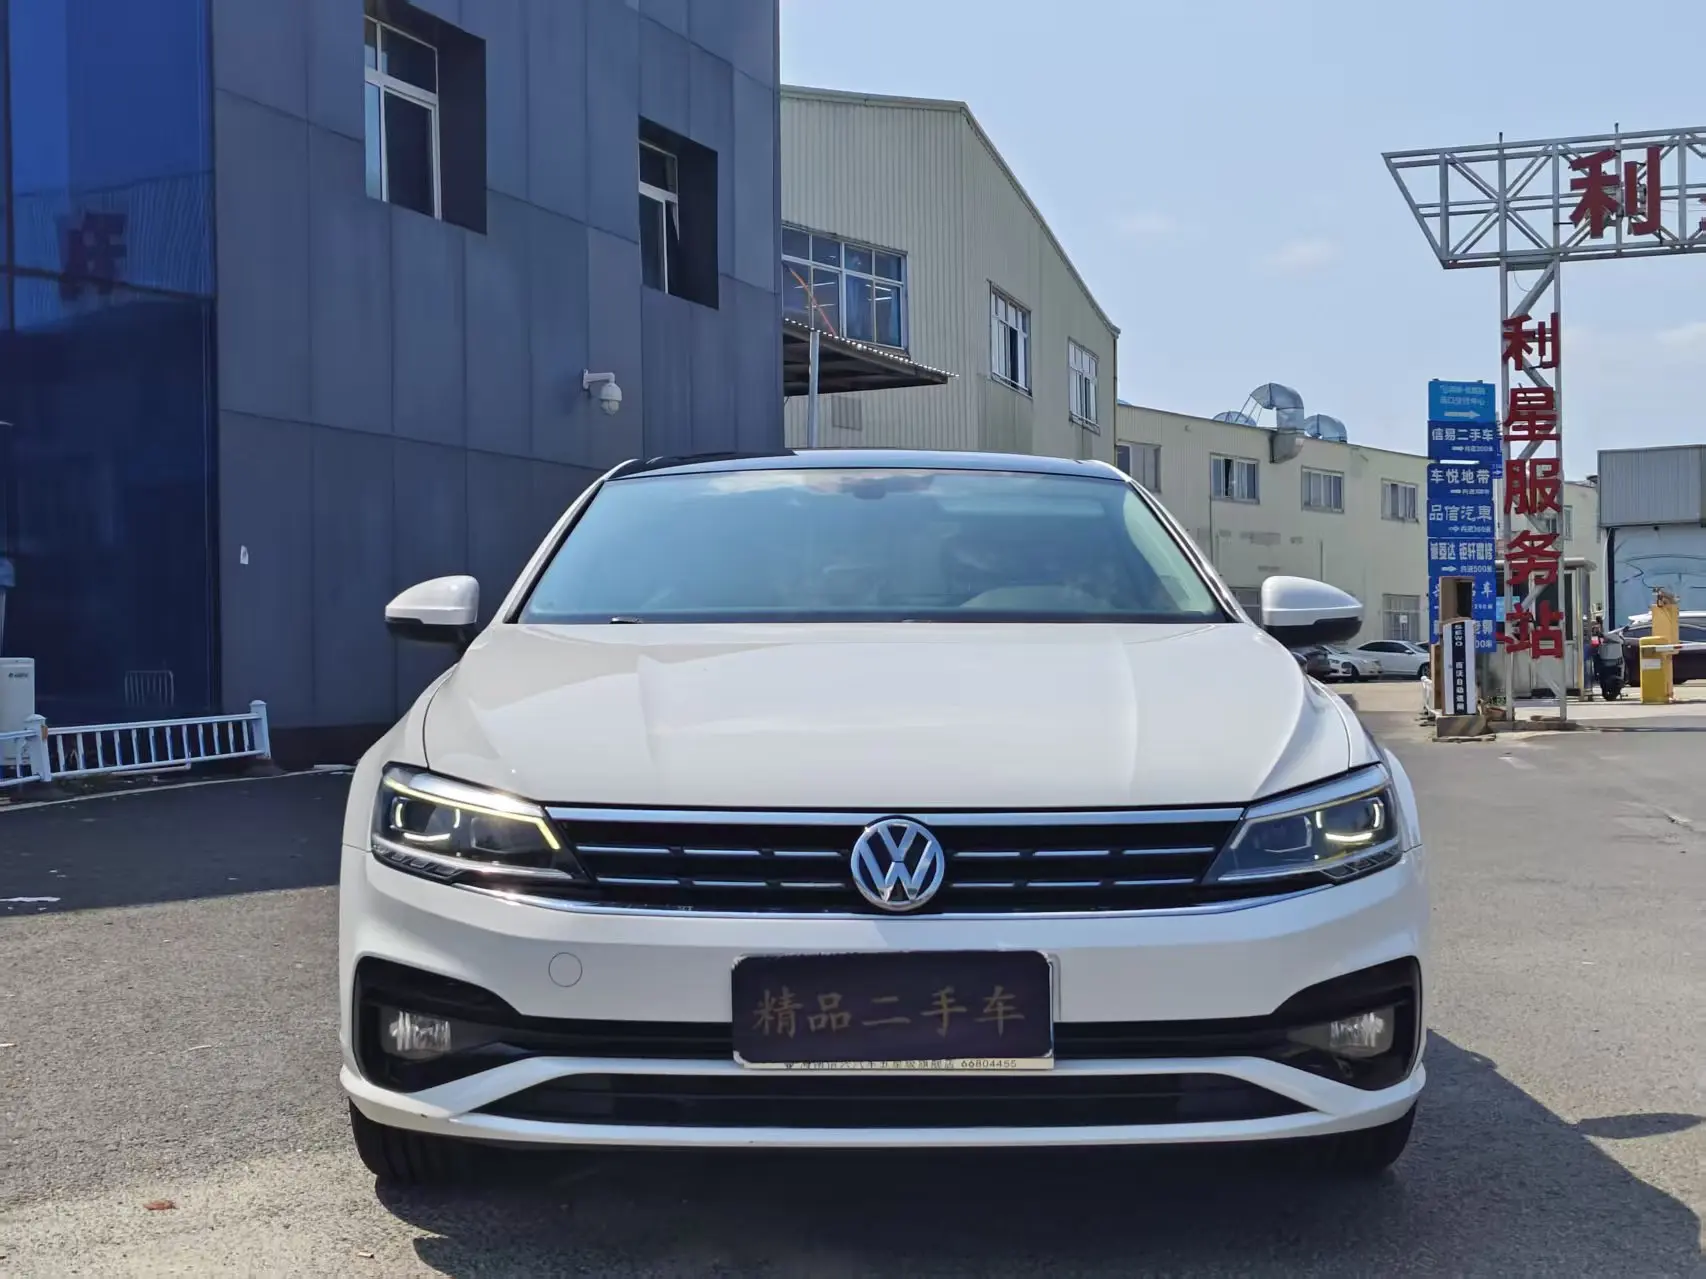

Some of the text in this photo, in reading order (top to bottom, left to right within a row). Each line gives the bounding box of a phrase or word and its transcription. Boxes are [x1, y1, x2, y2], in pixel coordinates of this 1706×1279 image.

[1432, 427, 1494, 442] 信易二手车
[1430, 468, 1490, 484] 车悦地带
[1502, 312, 1564, 660] 利星服务站
[1429, 504, 1492, 522] 品信汽車
[854, 821, 941, 908] VW
[752, 985, 1026, 1038] 精品二手车
[960, 1060, 1017, 1069] 66804455
